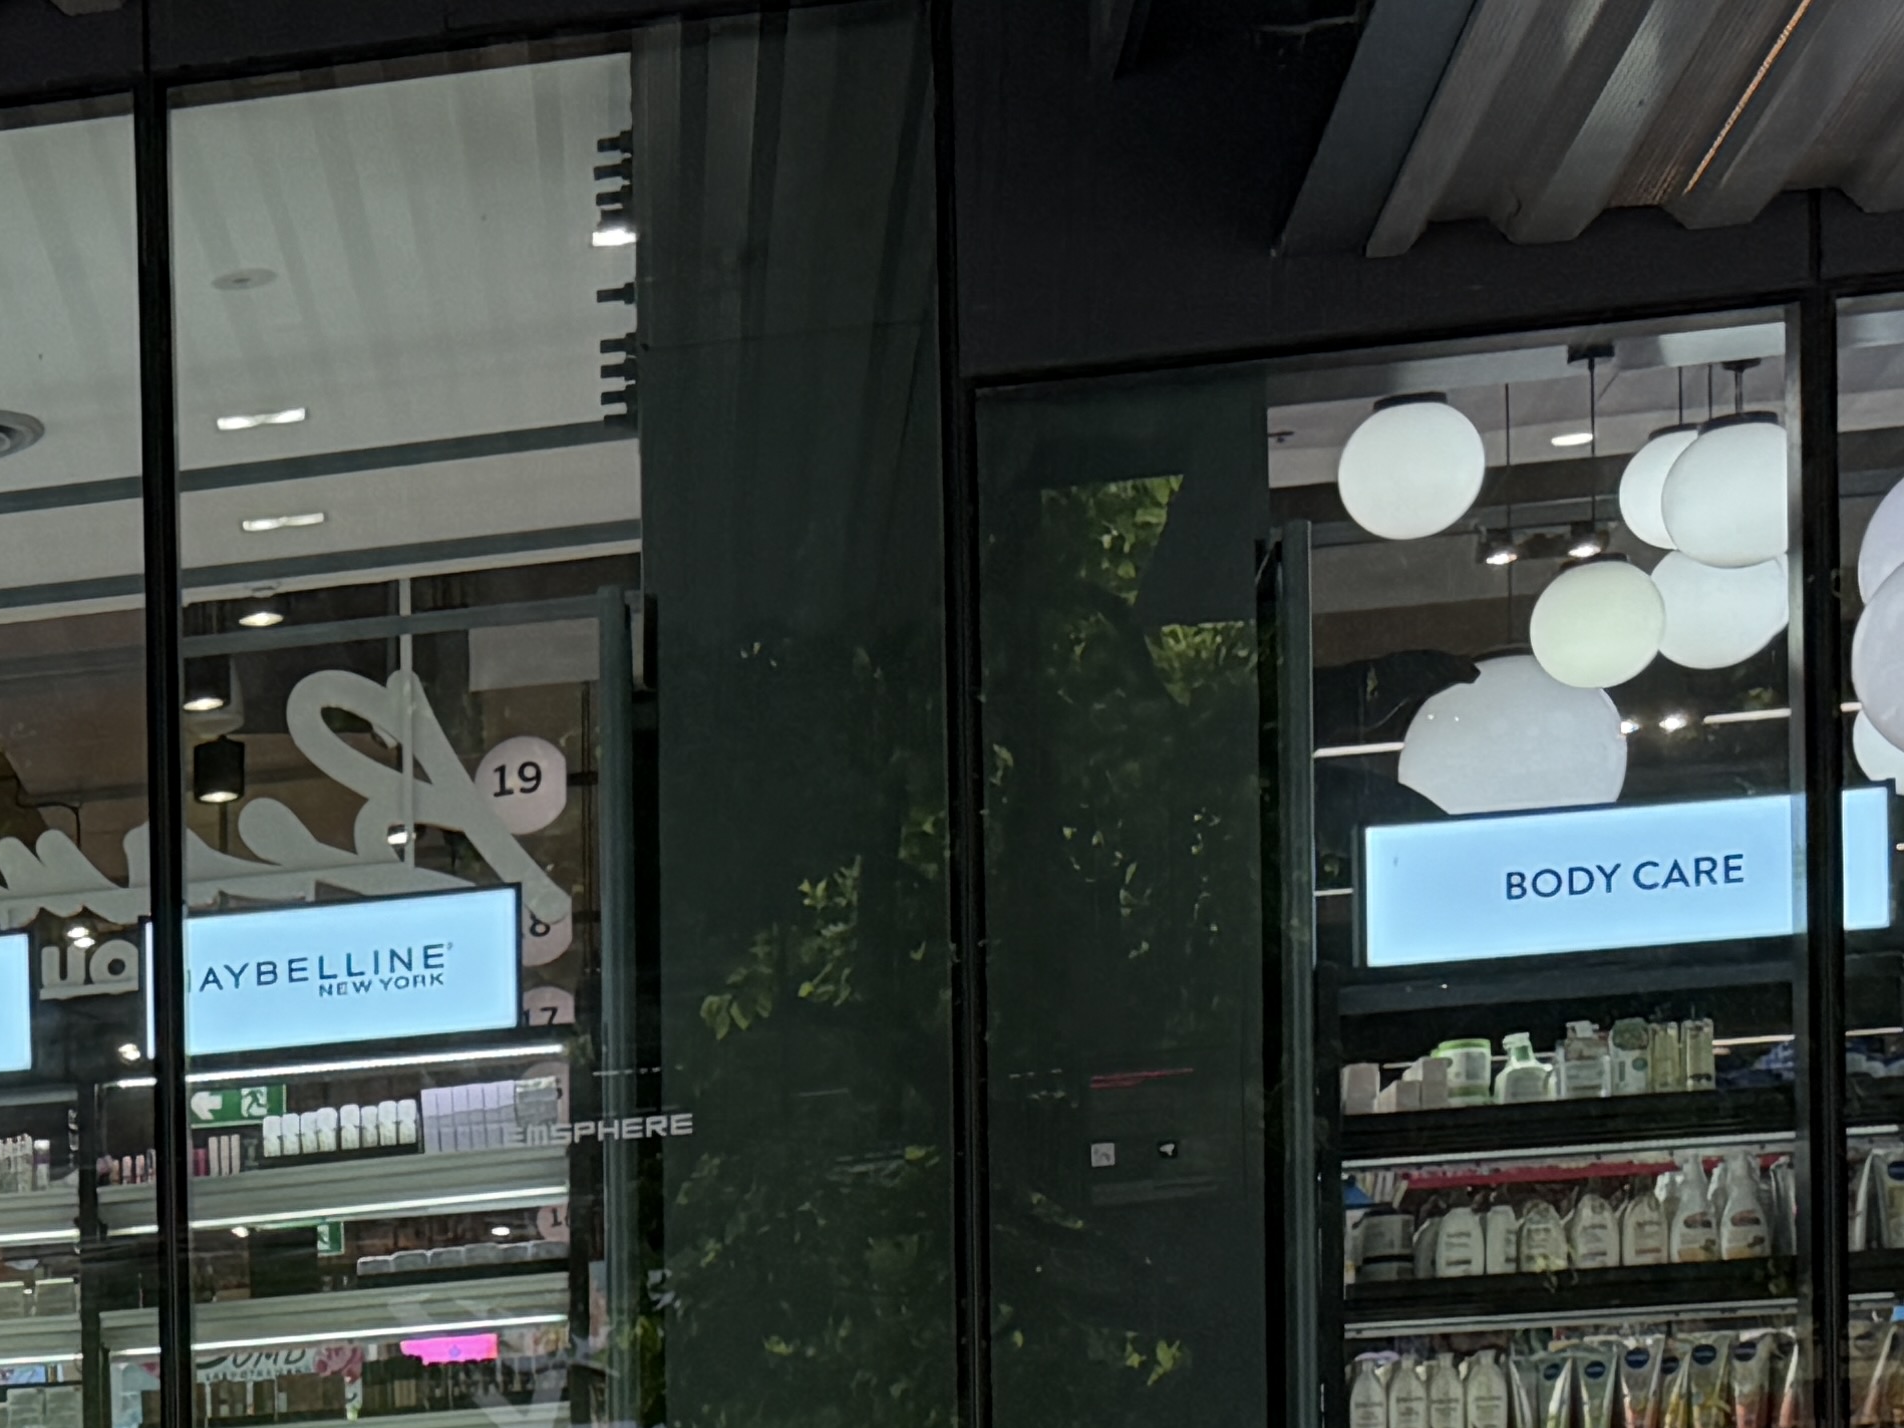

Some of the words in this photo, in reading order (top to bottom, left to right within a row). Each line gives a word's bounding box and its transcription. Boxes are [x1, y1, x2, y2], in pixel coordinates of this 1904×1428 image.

[492, 761, 543, 797] 19
[1506, 863, 1621, 900] BODY
[1633, 854, 1744, 890] CARE
[188, 943, 446, 992] AYBELLINE
[319, 979, 372, 997] NEW
[382, 972, 444, 991] YORK
[502, 1112, 693, 1147] EMSPHERE
